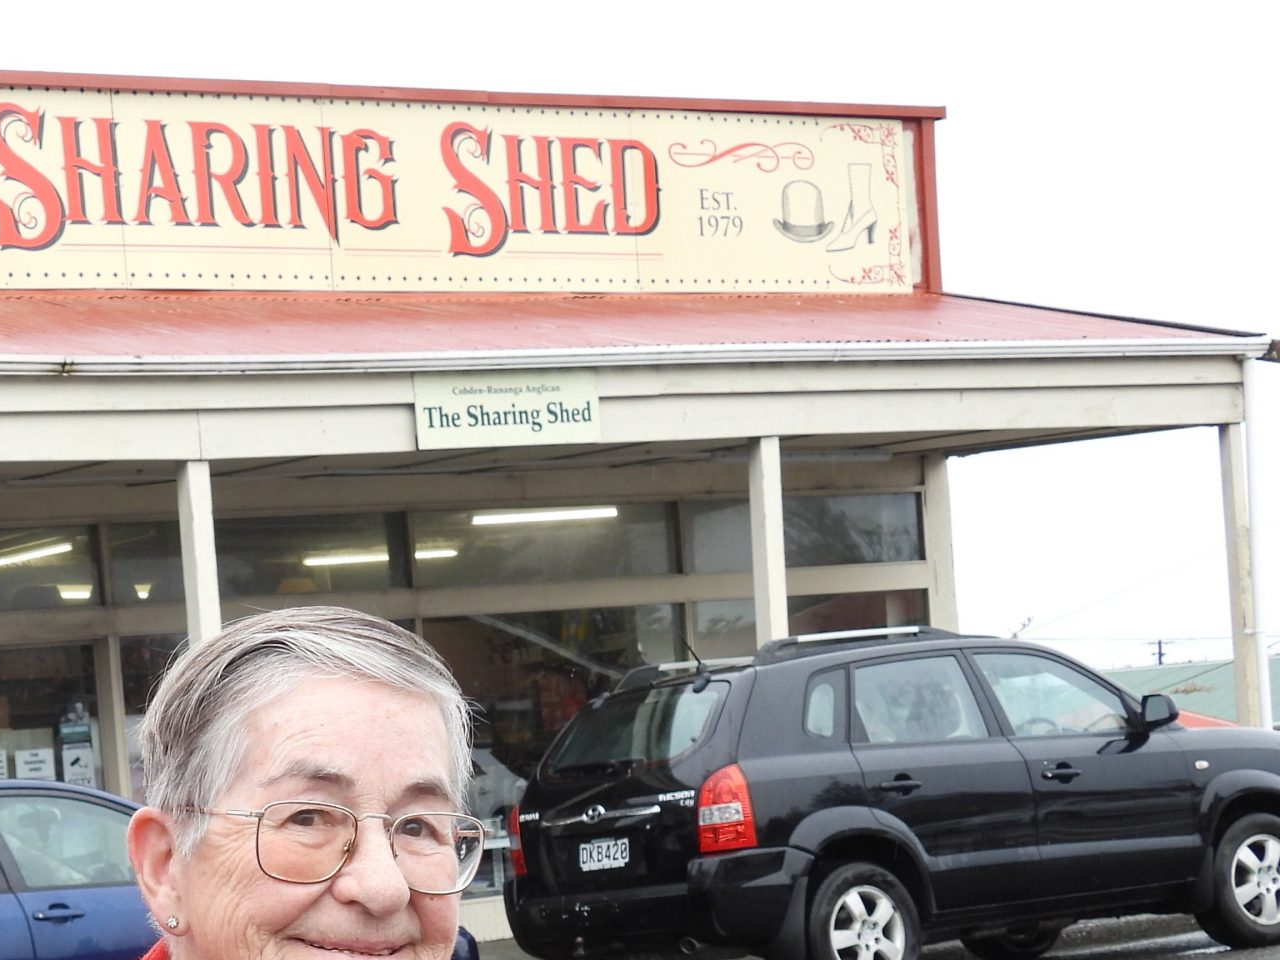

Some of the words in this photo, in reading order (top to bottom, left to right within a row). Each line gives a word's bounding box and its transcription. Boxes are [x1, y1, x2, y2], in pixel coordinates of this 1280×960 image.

[440, 121, 662, 258] SHED
[699, 188, 738, 211] EST.
[699, 215, 743, 237] 1979
[525, 383, 561, 394] Anglican
[423, 405, 462, 429] The
[466, 403, 543, 433] Sharing
[546, 400, 593, 424] Shed
[581, 842, 628, 865] DKB420
